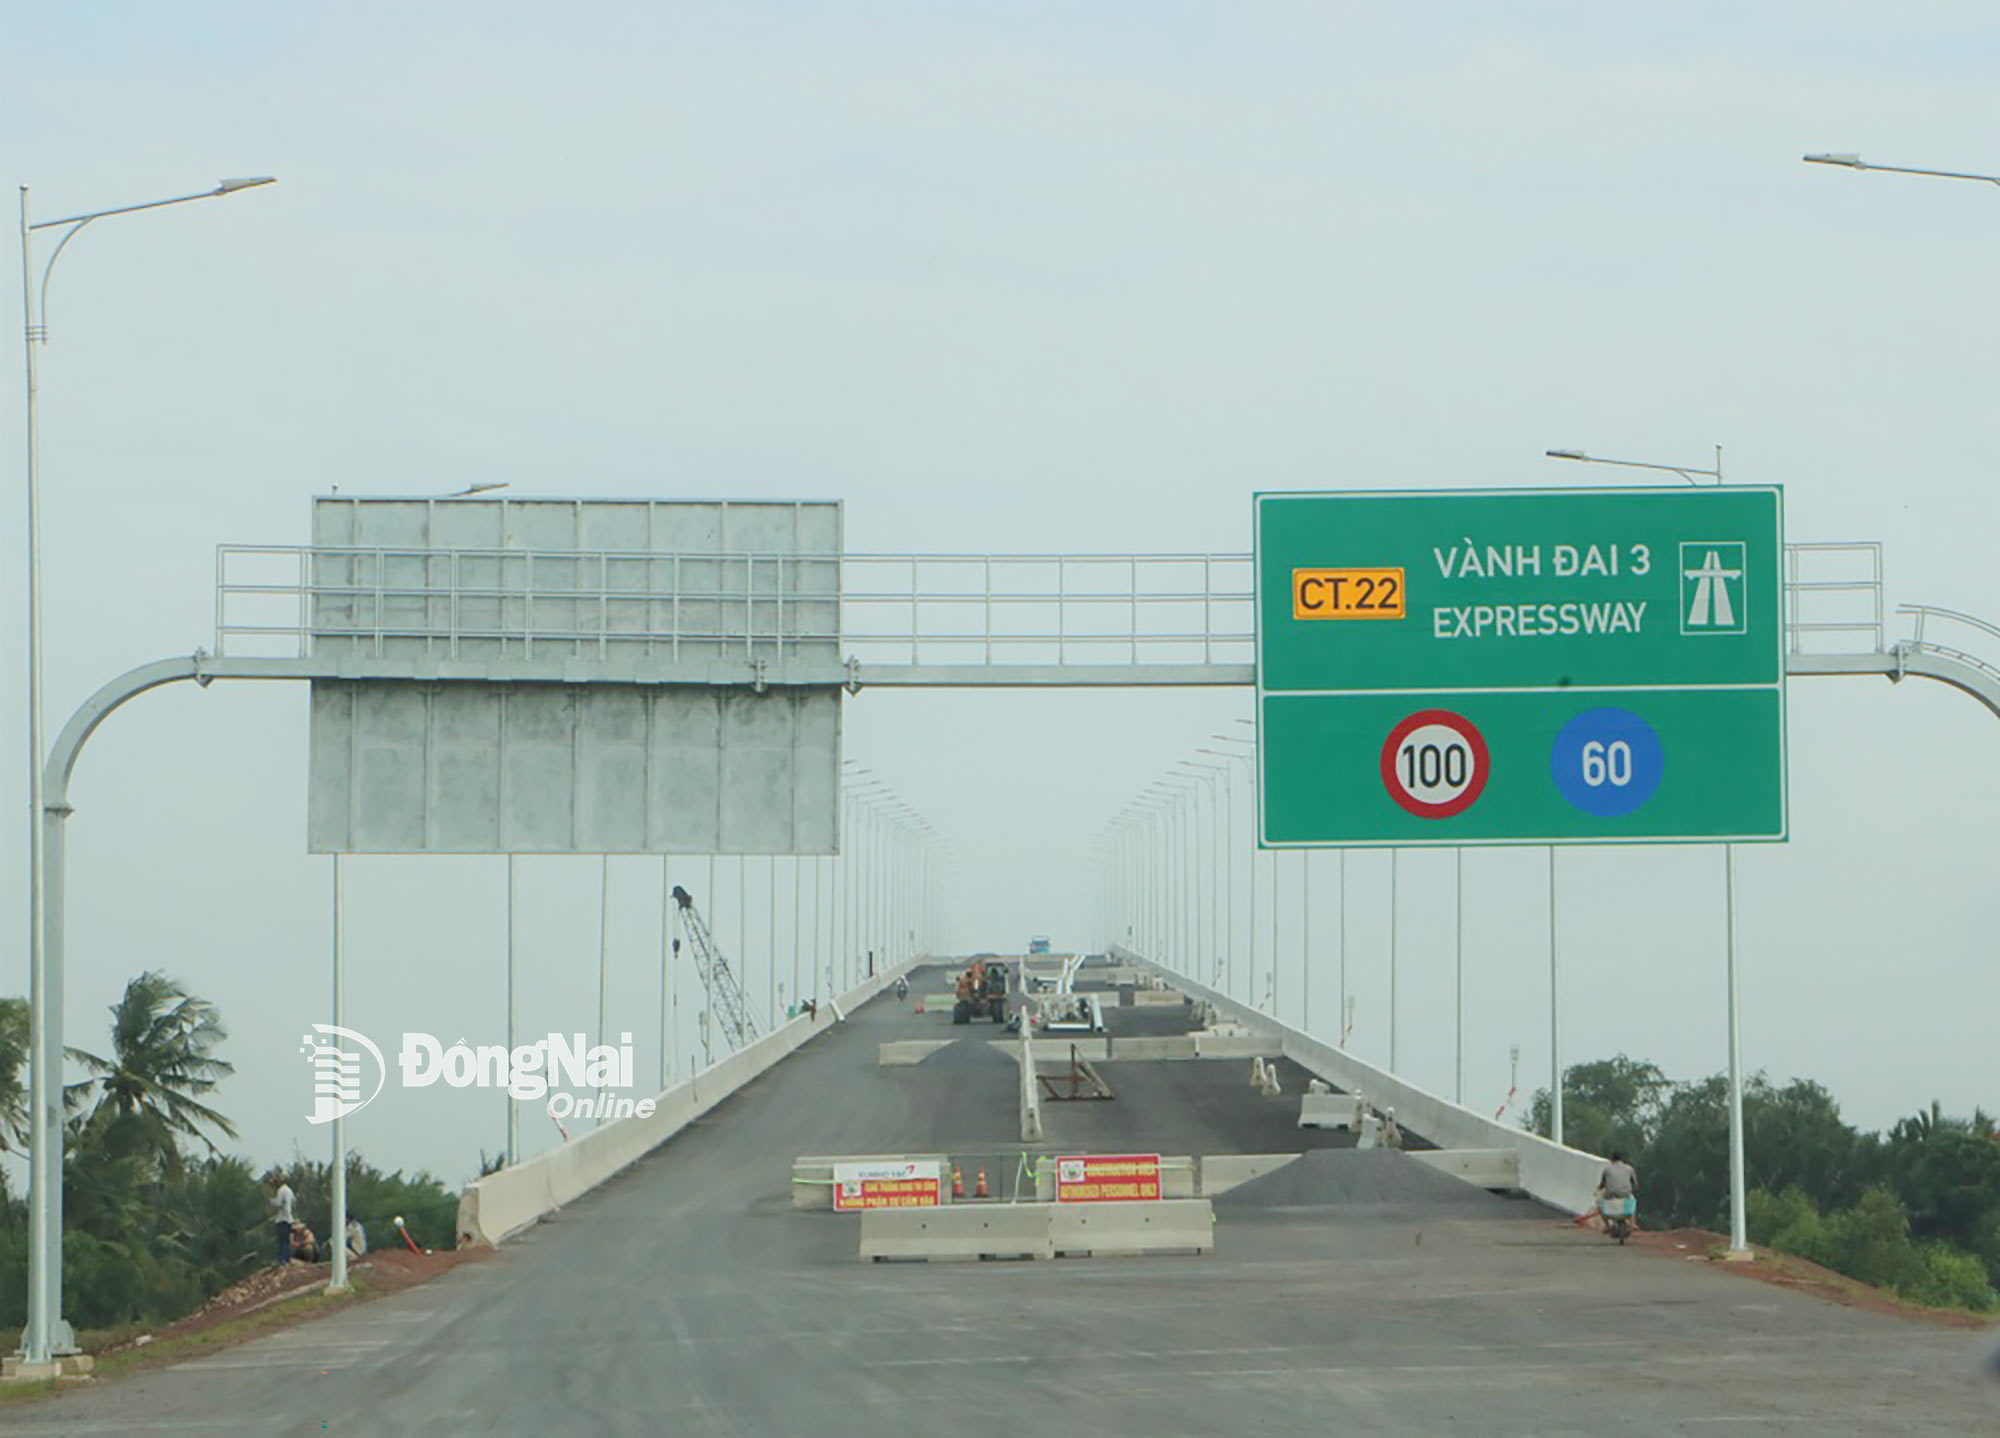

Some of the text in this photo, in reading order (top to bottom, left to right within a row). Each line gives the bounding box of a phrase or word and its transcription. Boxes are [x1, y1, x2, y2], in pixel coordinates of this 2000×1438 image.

[1433, 538, 1651, 578] VÀNH ĐAI 3
[1299, 577, 1398, 610] CT.22
[1433, 602, 1647, 638] EXPRESSWAY
[1402, 744, 1467, 788] 100
[1582, 740, 1632, 787] 60
